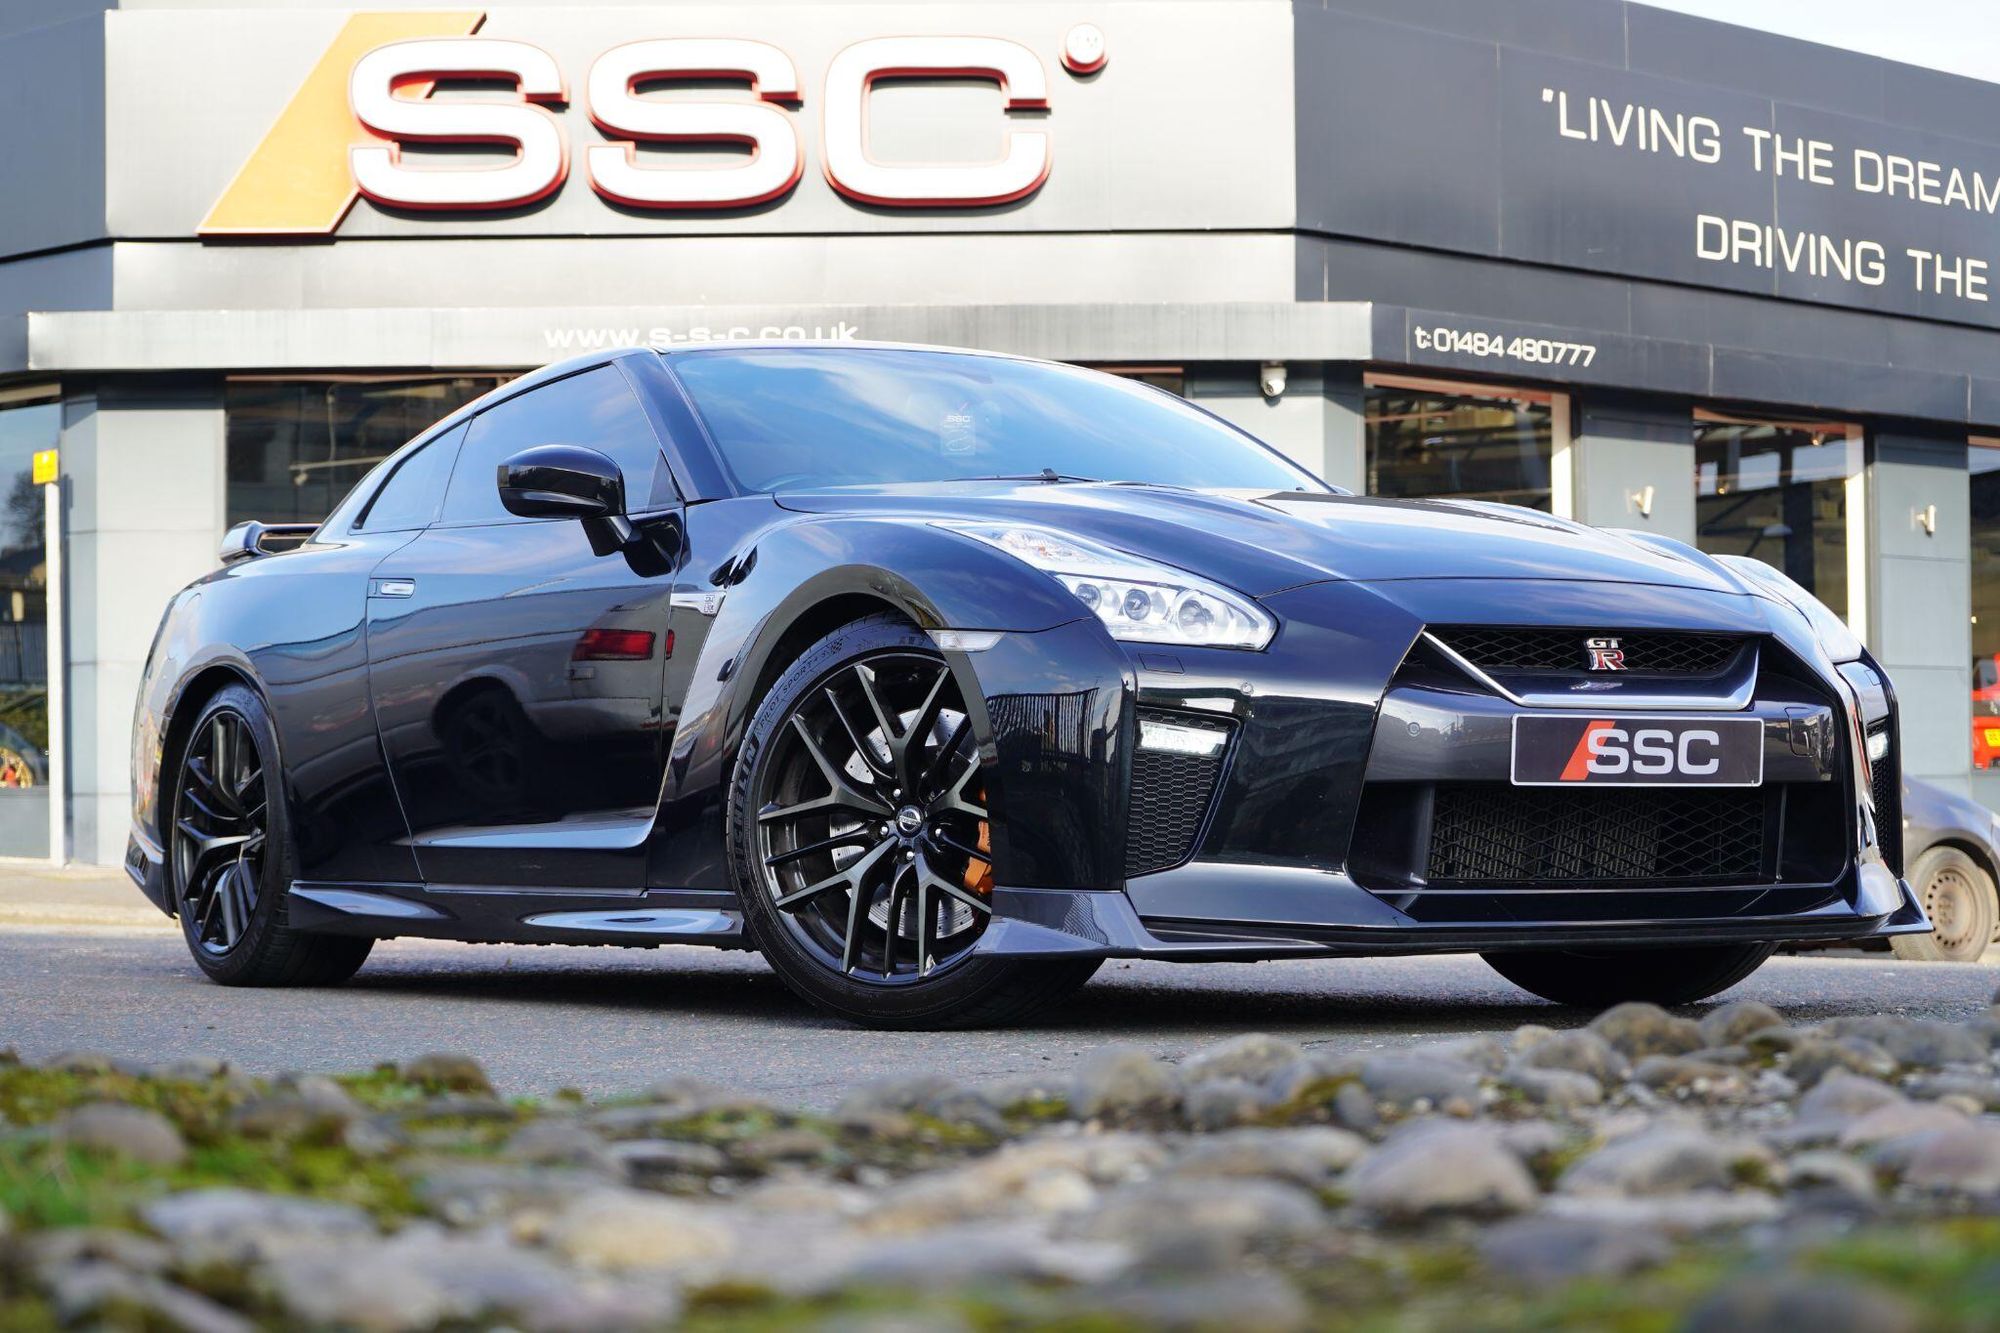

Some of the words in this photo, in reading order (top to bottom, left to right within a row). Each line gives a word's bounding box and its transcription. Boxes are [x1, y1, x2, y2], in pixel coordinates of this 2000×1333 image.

[350, 37, 1052, 212] SSC
[1743, 126, 1835, 186] THE
[1696, 213, 1886, 286] DRIVING
[1906, 248, 1990, 302] THE
[544, 321, 858, 348] www.s-s-ccouk
[1506, 337, 1597, 367] 480777
[1586, 728, 1720, 775] SSC
